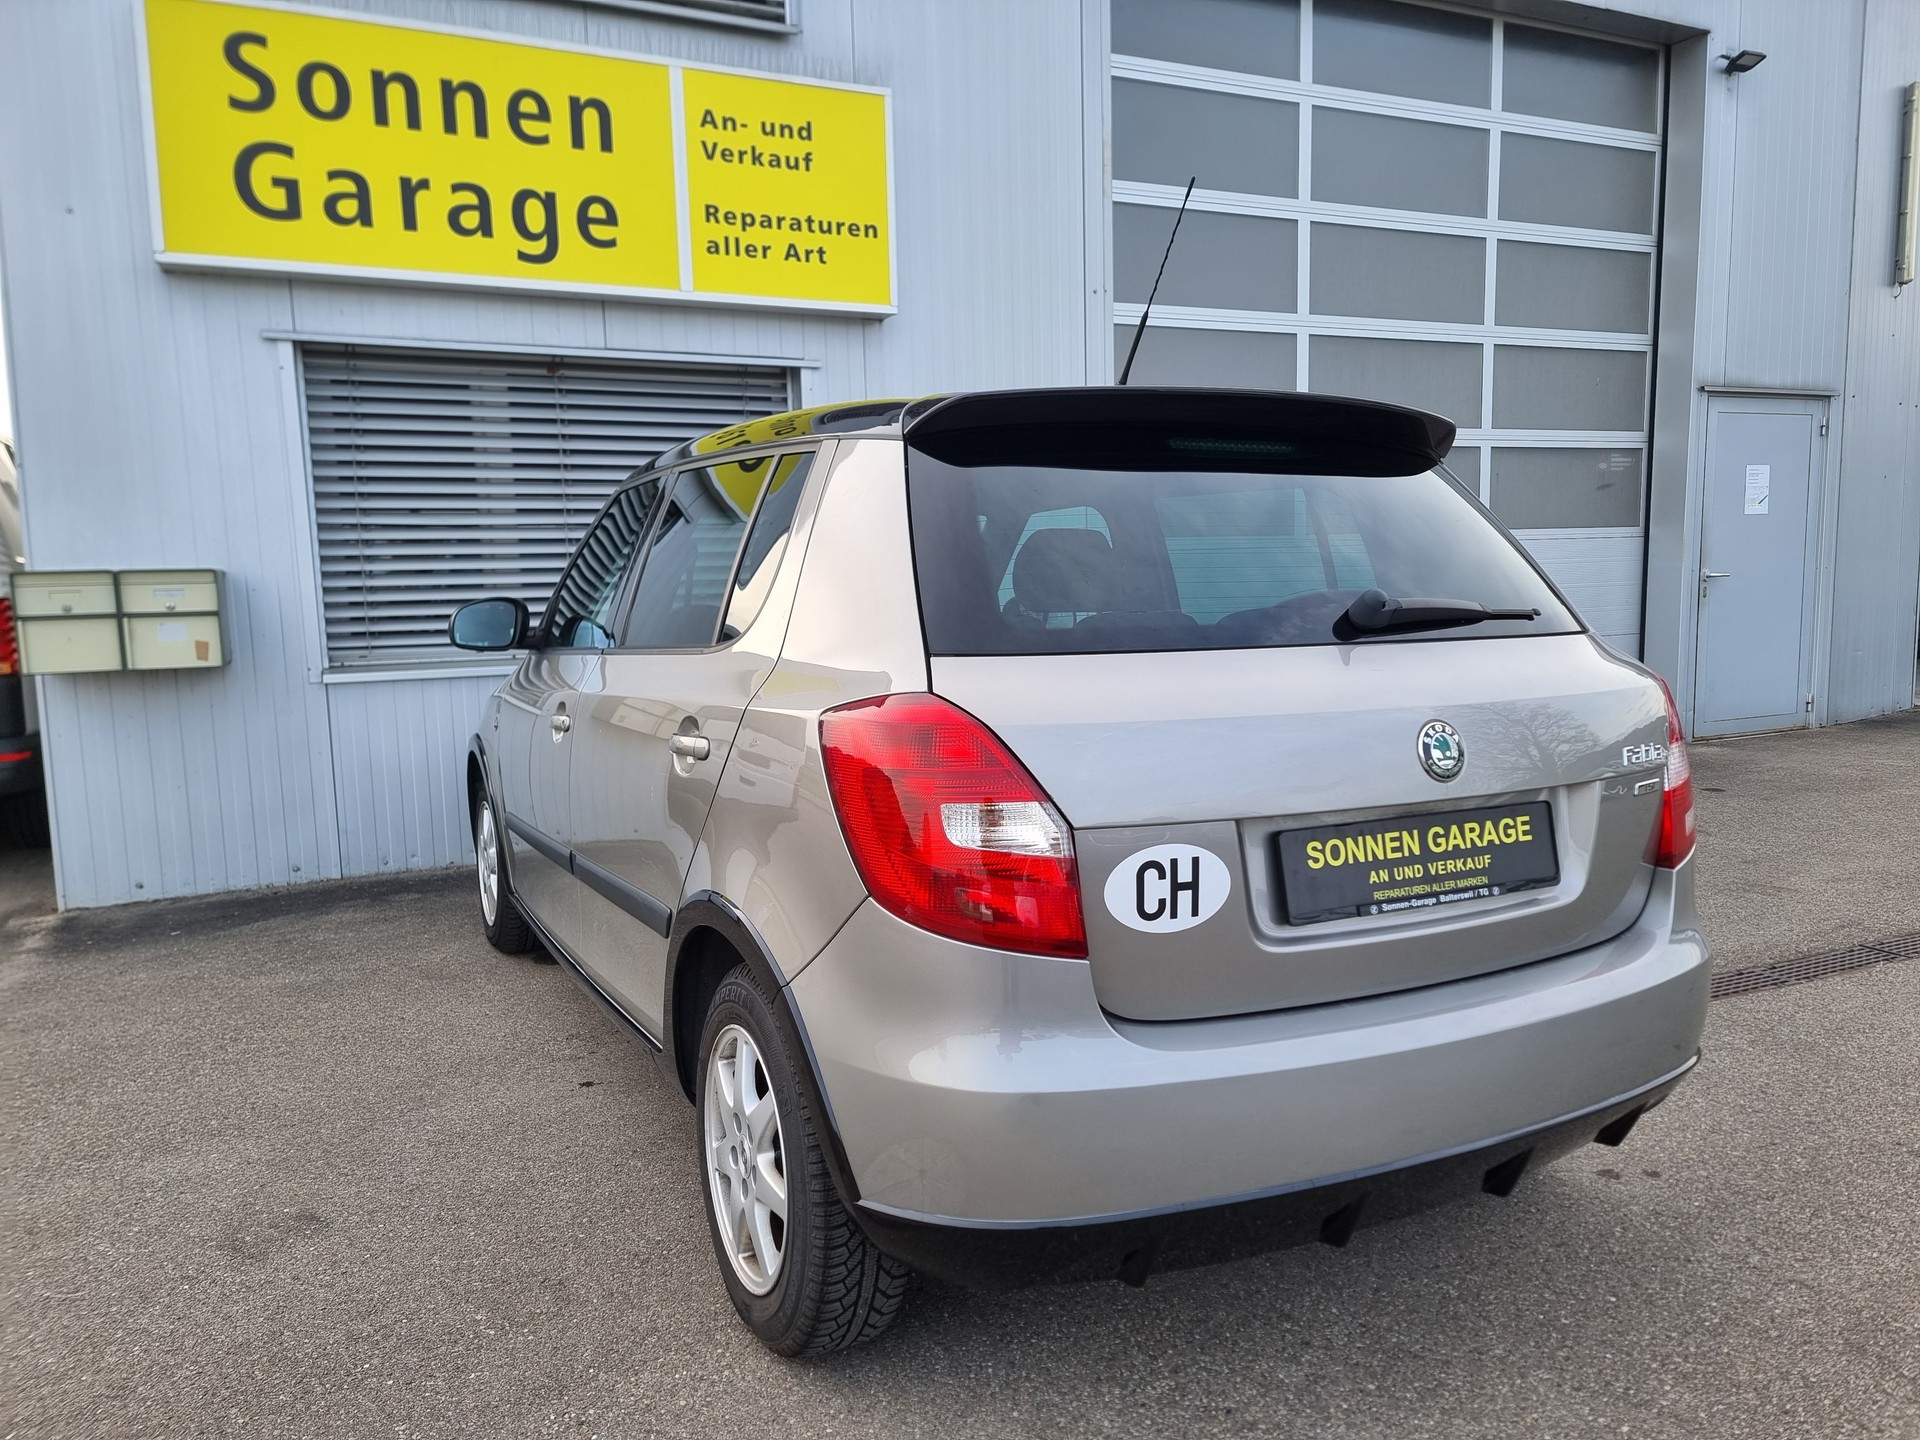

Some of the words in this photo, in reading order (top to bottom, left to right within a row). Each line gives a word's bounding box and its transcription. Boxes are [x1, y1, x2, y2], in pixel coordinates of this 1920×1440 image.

[222, 31, 614, 153] Sonnen
[700, 108, 749, 132] An-
[760, 118, 813, 142] und
[701, 139, 813, 173] Verkauf
[231, 140, 620, 265] Garage
[703, 202, 880, 240] Reparaturen
[705, 235, 772, 261] aller
[783, 241, 828, 266] Art
[1622, 742, 1663, 766] Fabia
[1305, 829, 1421, 870] SONNEN
[1426, 815, 1533, 854] GARAGE
[1369, 869, 1390, 885] AN
[1394, 864, 1424, 881] UND
[1427, 854, 1493, 876] VERKAUF
[1135, 856, 1200, 922] CH
[1373, 884, 1431, 901] REPARATUREN
[1432, 880, 1457, 893] ALLER
[1457, 875, 1489, 889] MARKEN
[1382, 896, 1437, 912] Sonnen-Garage
